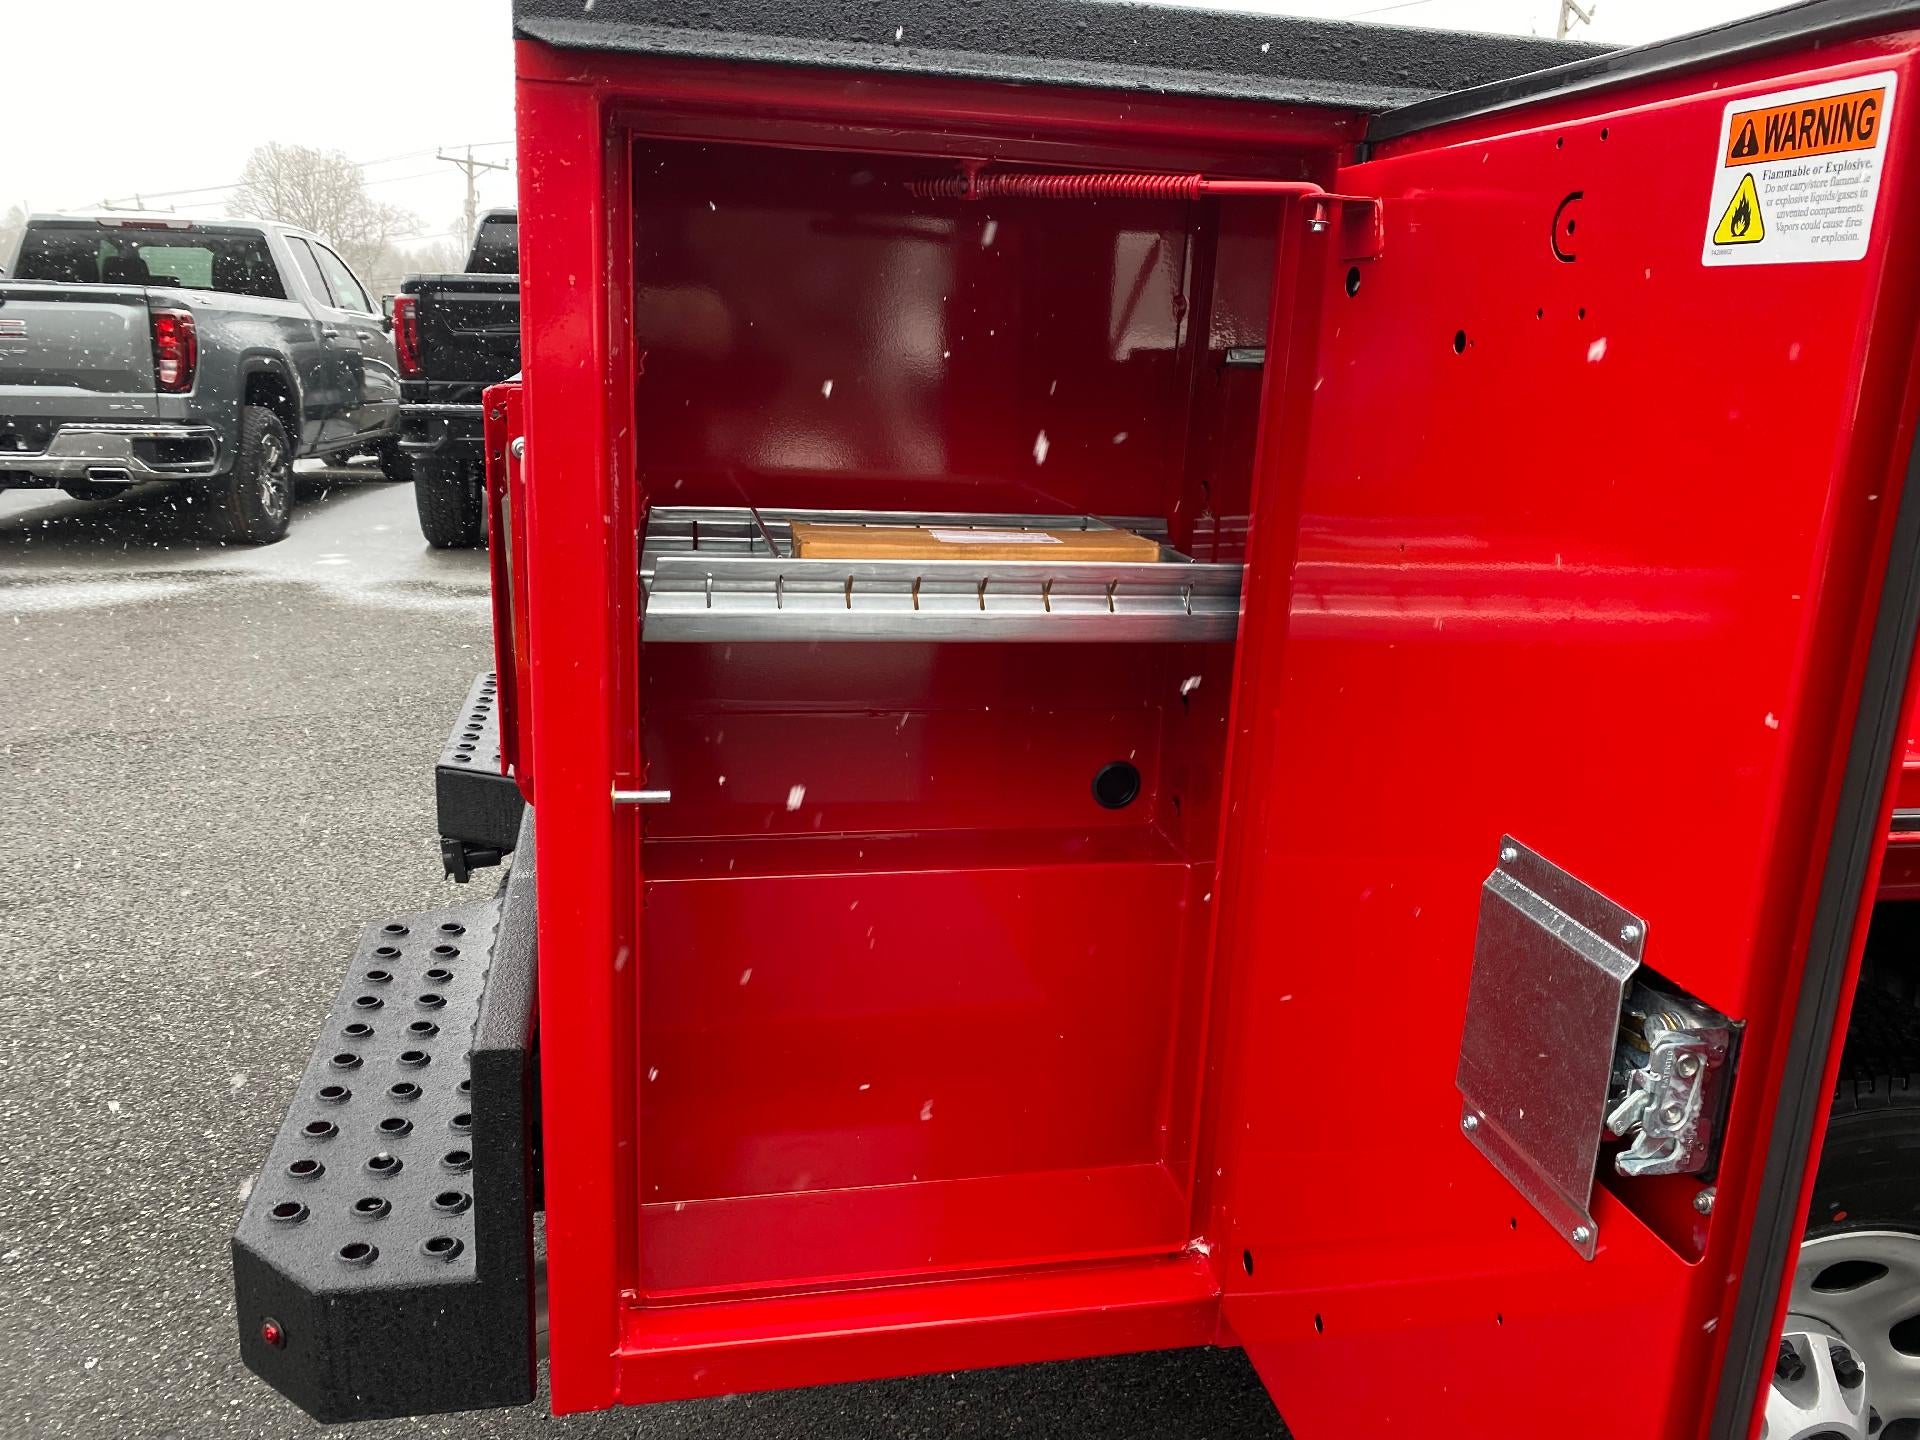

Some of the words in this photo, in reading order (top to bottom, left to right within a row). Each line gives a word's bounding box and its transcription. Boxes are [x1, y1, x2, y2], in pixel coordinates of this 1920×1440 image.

[1764, 98, 1877, 154] WARNING
[1762, 166, 1810, 180] Flammable
[1812, 165, 1823, 175] or
[1825, 159, 1872, 175] Explosive.
[1765, 183, 1775, 193] Do
[1777, 182, 1788, 192] not
[1775, 195, 1809, 207] explosive
[1860, 188, 1868, 198] in
[1776, 221, 1799, 234] Vapors
[1800, 219, 1822, 231] could
[1822, 220, 1844, 229] cause
[1845, 216, 1863, 228] fires
[1821, 231, 1860, 245] explosion.
